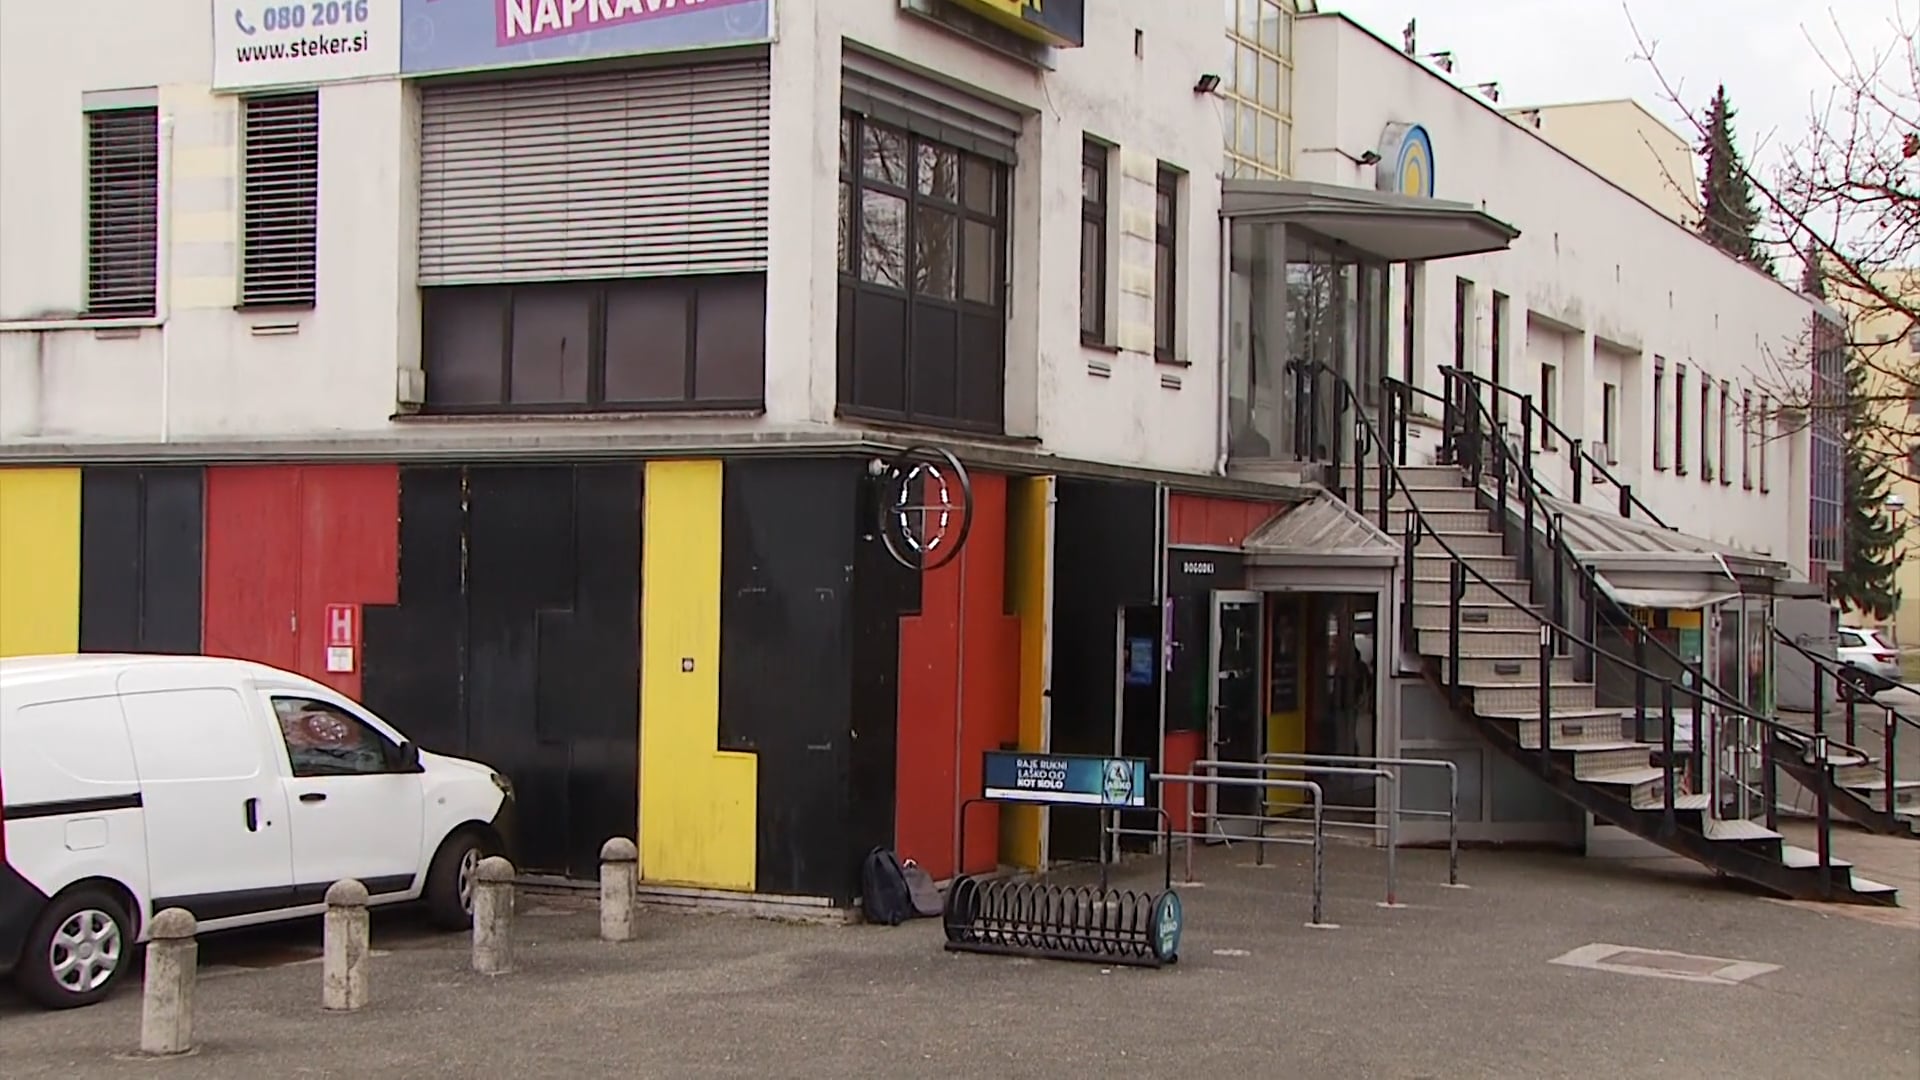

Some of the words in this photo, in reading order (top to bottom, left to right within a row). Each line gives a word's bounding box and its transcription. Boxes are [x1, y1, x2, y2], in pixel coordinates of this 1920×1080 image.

[263, 5, 305, 31] 080
[312, 0, 368, 26] 2016
[237, 30, 368, 62] www.steker.si
[332, 608, 352, 642] H
[1017, 759, 1038, 769] RAJE
[1040, 760, 1067, 770] RUKNI
[1017, 778, 1036, 788] KOT
[1037, 779, 1064, 789] KOLO
